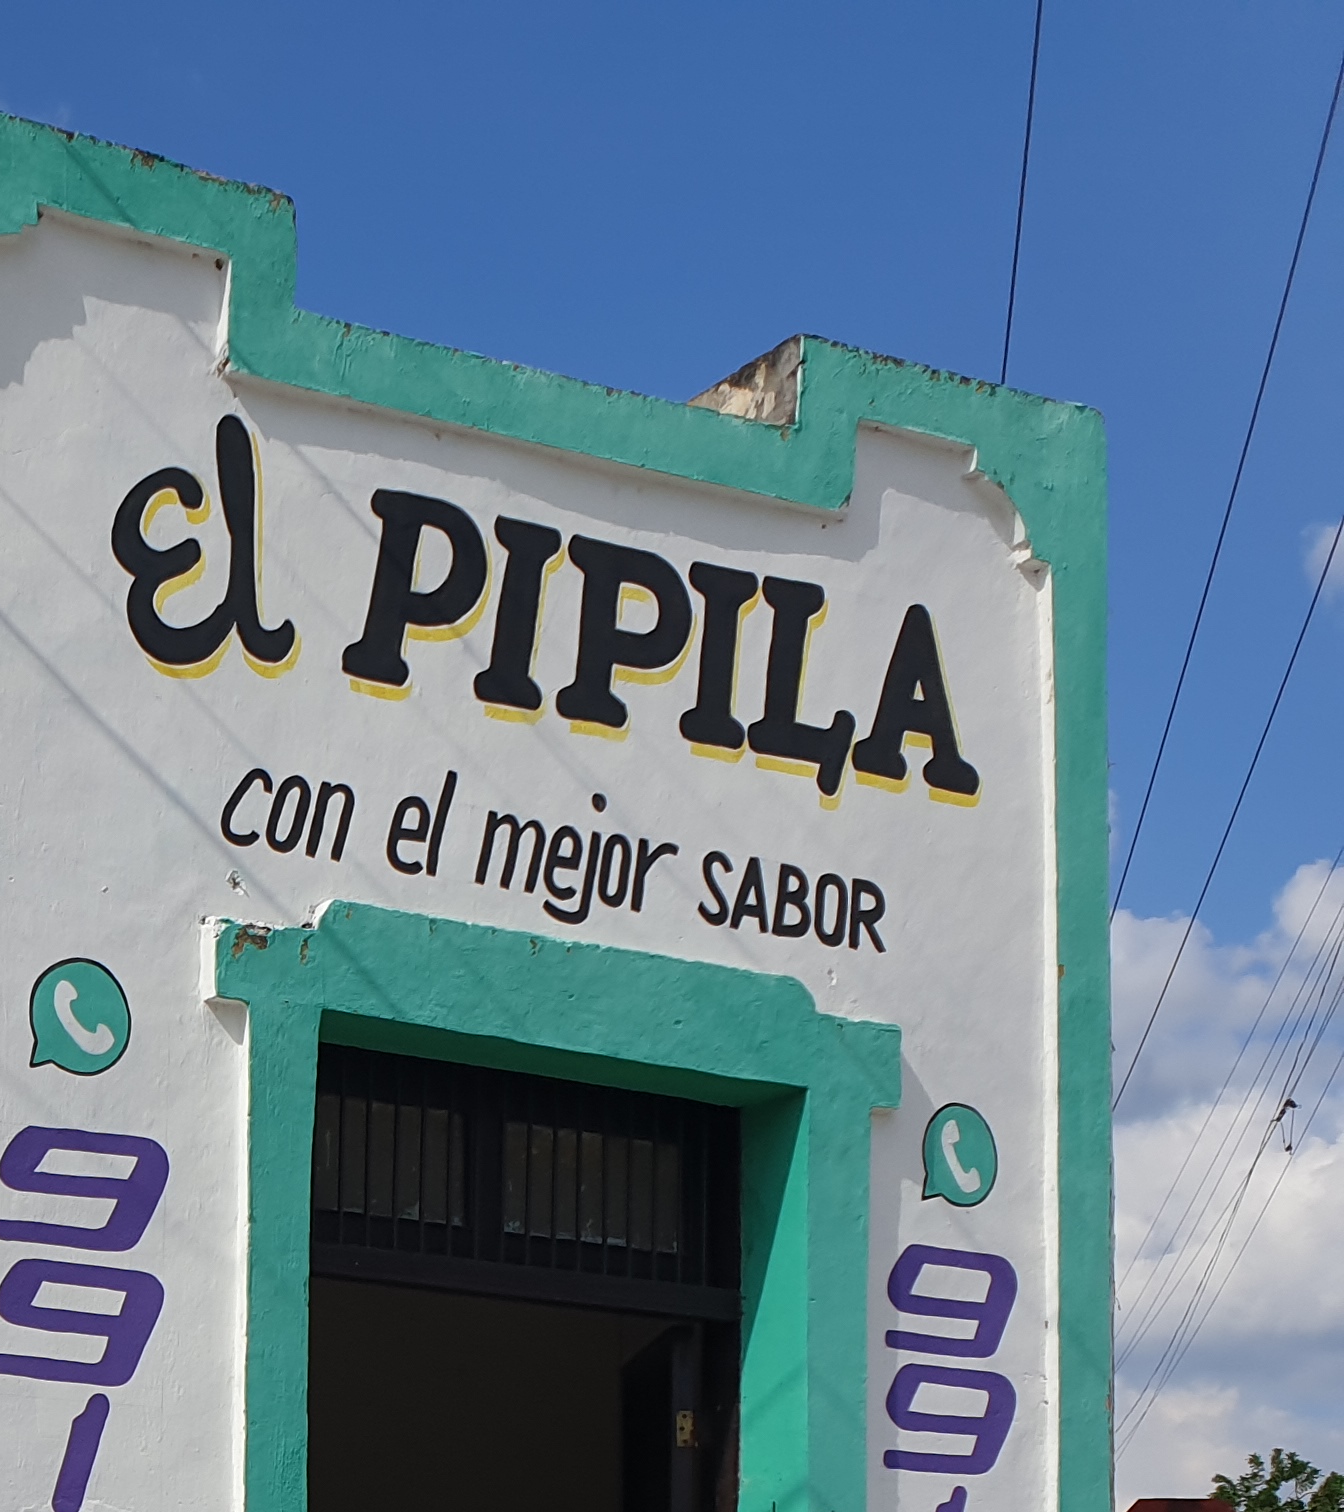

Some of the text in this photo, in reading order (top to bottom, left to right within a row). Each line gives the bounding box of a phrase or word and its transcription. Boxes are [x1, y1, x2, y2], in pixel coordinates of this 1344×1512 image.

[112, 414, 982, 809] El PIPILA
[220, 767, 887, 953] con el mejor SABOR
